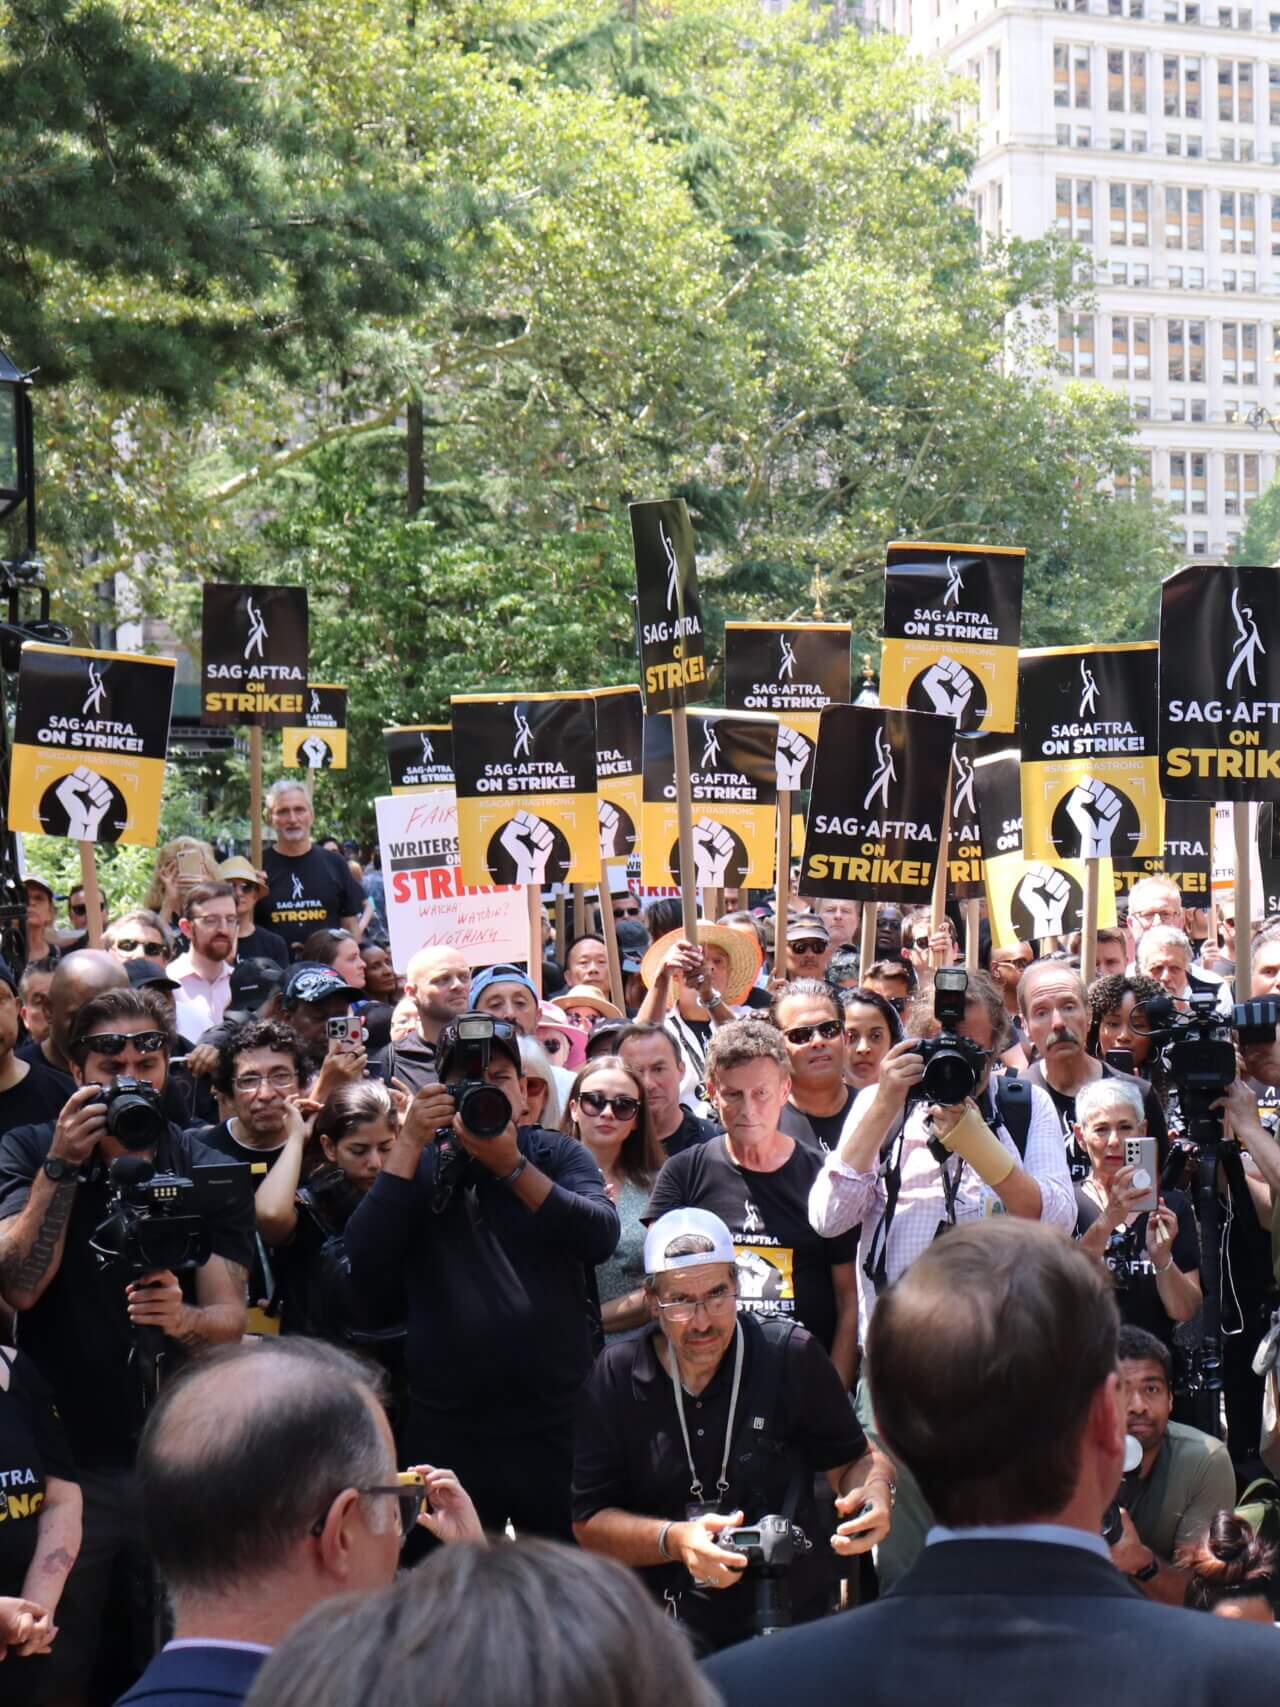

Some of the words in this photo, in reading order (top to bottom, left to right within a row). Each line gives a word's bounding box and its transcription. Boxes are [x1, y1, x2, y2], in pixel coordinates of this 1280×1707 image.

[904, 621, 930, 636] ON
[934, 624, 998, 641] STRIKE!
[245, 682, 266, 693] ON
[205, 692, 304, 713] STRIKE!
[743, 696, 768, 709] ON
[771, 696, 831, 709] STRIKE!
[37, 728, 66, 744] ON
[71, 732, 144, 752] STRIKE!
[1042, 740, 1069, 755] ON
[1073, 737, 1145, 754] STRIKE!
[1228, 729, 1260, 746] ON
[402, 774, 419, 784] ON
[476, 778, 502, 793] ON
[507, 775, 576, 791] STRIKE!
[693, 786, 757, 800] STRIKE!
[389, 835, 460, 858] WRITERS
[861, 843, 886, 857] ON
[995, 832, 1019, 851] ON
[958, 845, 982, 859] ON
[807, 854, 932, 886] STRIKE!
[1144, 860, 1164, 871] ON
[271, 910, 327, 922] STRONG
